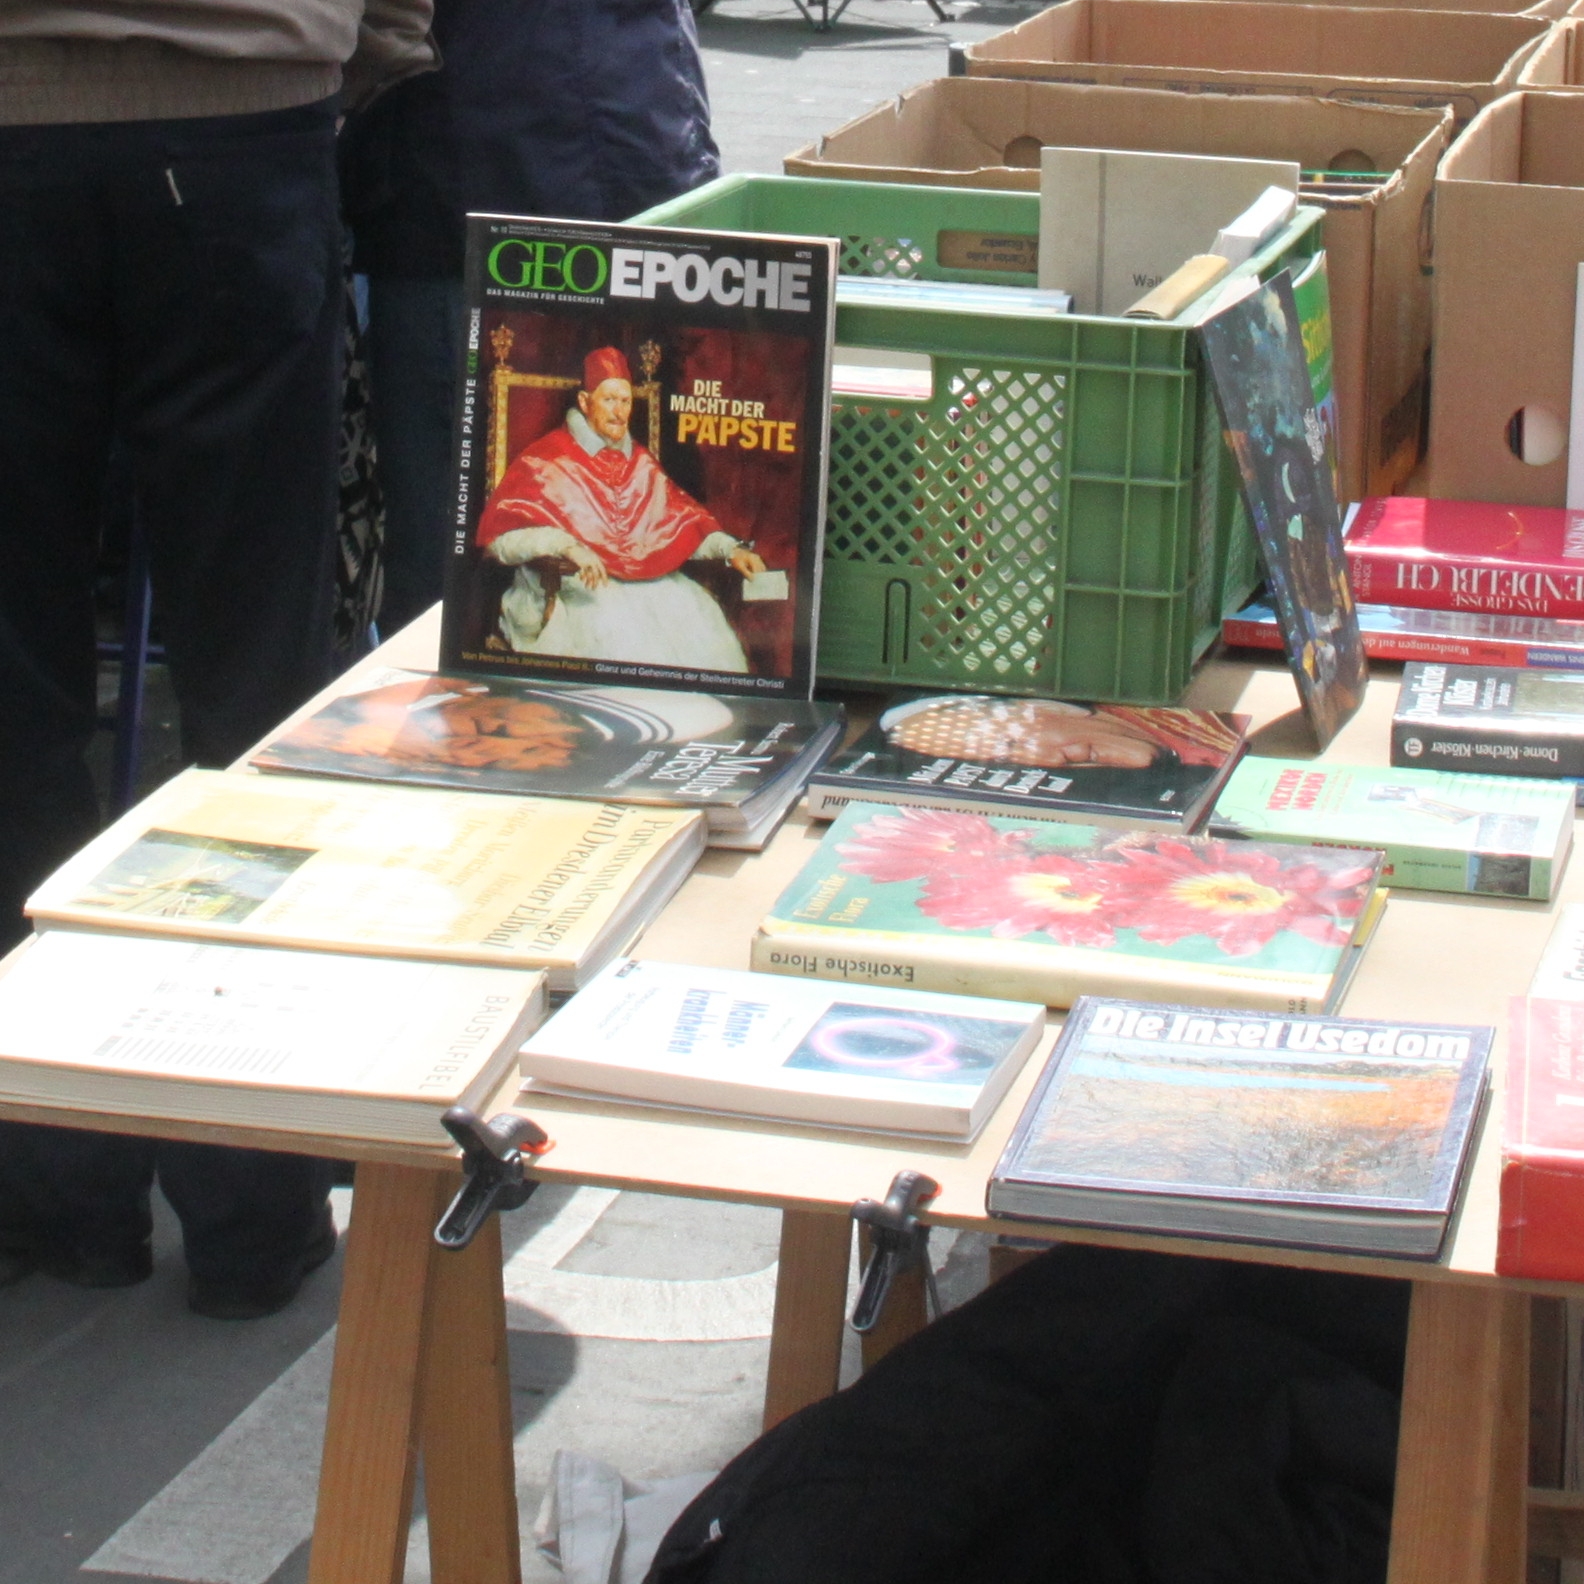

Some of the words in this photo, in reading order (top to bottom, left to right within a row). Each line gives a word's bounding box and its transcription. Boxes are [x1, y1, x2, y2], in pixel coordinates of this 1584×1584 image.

[487, 238, 608, 294] GEO
[609, 246, 813, 313] EPOCHE
[486, 287, 503, 298] DAS
[504, 289, 540, 300] MAGAZIN
[558, 293, 605, 305] GESCHICHTE
[469, 307, 481, 350] EPOCHE
[463, 377, 477, 437] PÄPSTE
[669, 394, 730, 416] MACHT
[731, 398, 765, 419] DER
[693, 379, 722, 399] DIE
[676, 413, 797, 453] PÄPSTE
[460, 439, 472, 469] DER
[456, 473, 469, 528] MACHT
[454, 530, 465, 555] DIE
[1450, 589, 1517, 611] GROSSE
[1518, 594, 1550, 614] DAS
[1379, 637, 1401, 654] auf
[1406, 639, 1470, 659] Wanderungen
[595, 663, 619, 674] Glanz
[620, 665, 637, 676] und
[638, 666, 683, 680] Geheimnis
[684, 670, 699, 682] der
[700, 672, 756, 687] Stellvertreter
[756, 676, 786, 689] Christi
[649, 739, 746, 782] Teresa
[675, 753, 775, 798] Mutter
[1291, 772, 1328, 811] NORDEN
[592, 802, 637, 830] im
[527, 827, 618, 907] Dresdener
[527, 818, 674, 953] Parkwanderungen
[793, 872, 848, 921] Exotische
[827, 896, 871, 924] Flora
[479, 902, 551, 950] Elbtal
[769, 951, 817, 975] Flora
[825, 956, 915, 983] Exotische
[666, 986, 728, 1055] krankheiten
[1087, 1005, 1168, 1041] Die
[1168, 1011, 1285, 1050] Insel
[1285, 1020, 1471, 1060] Usedom
[415, 993, 512, 1094] BAUSTILFIBEL
